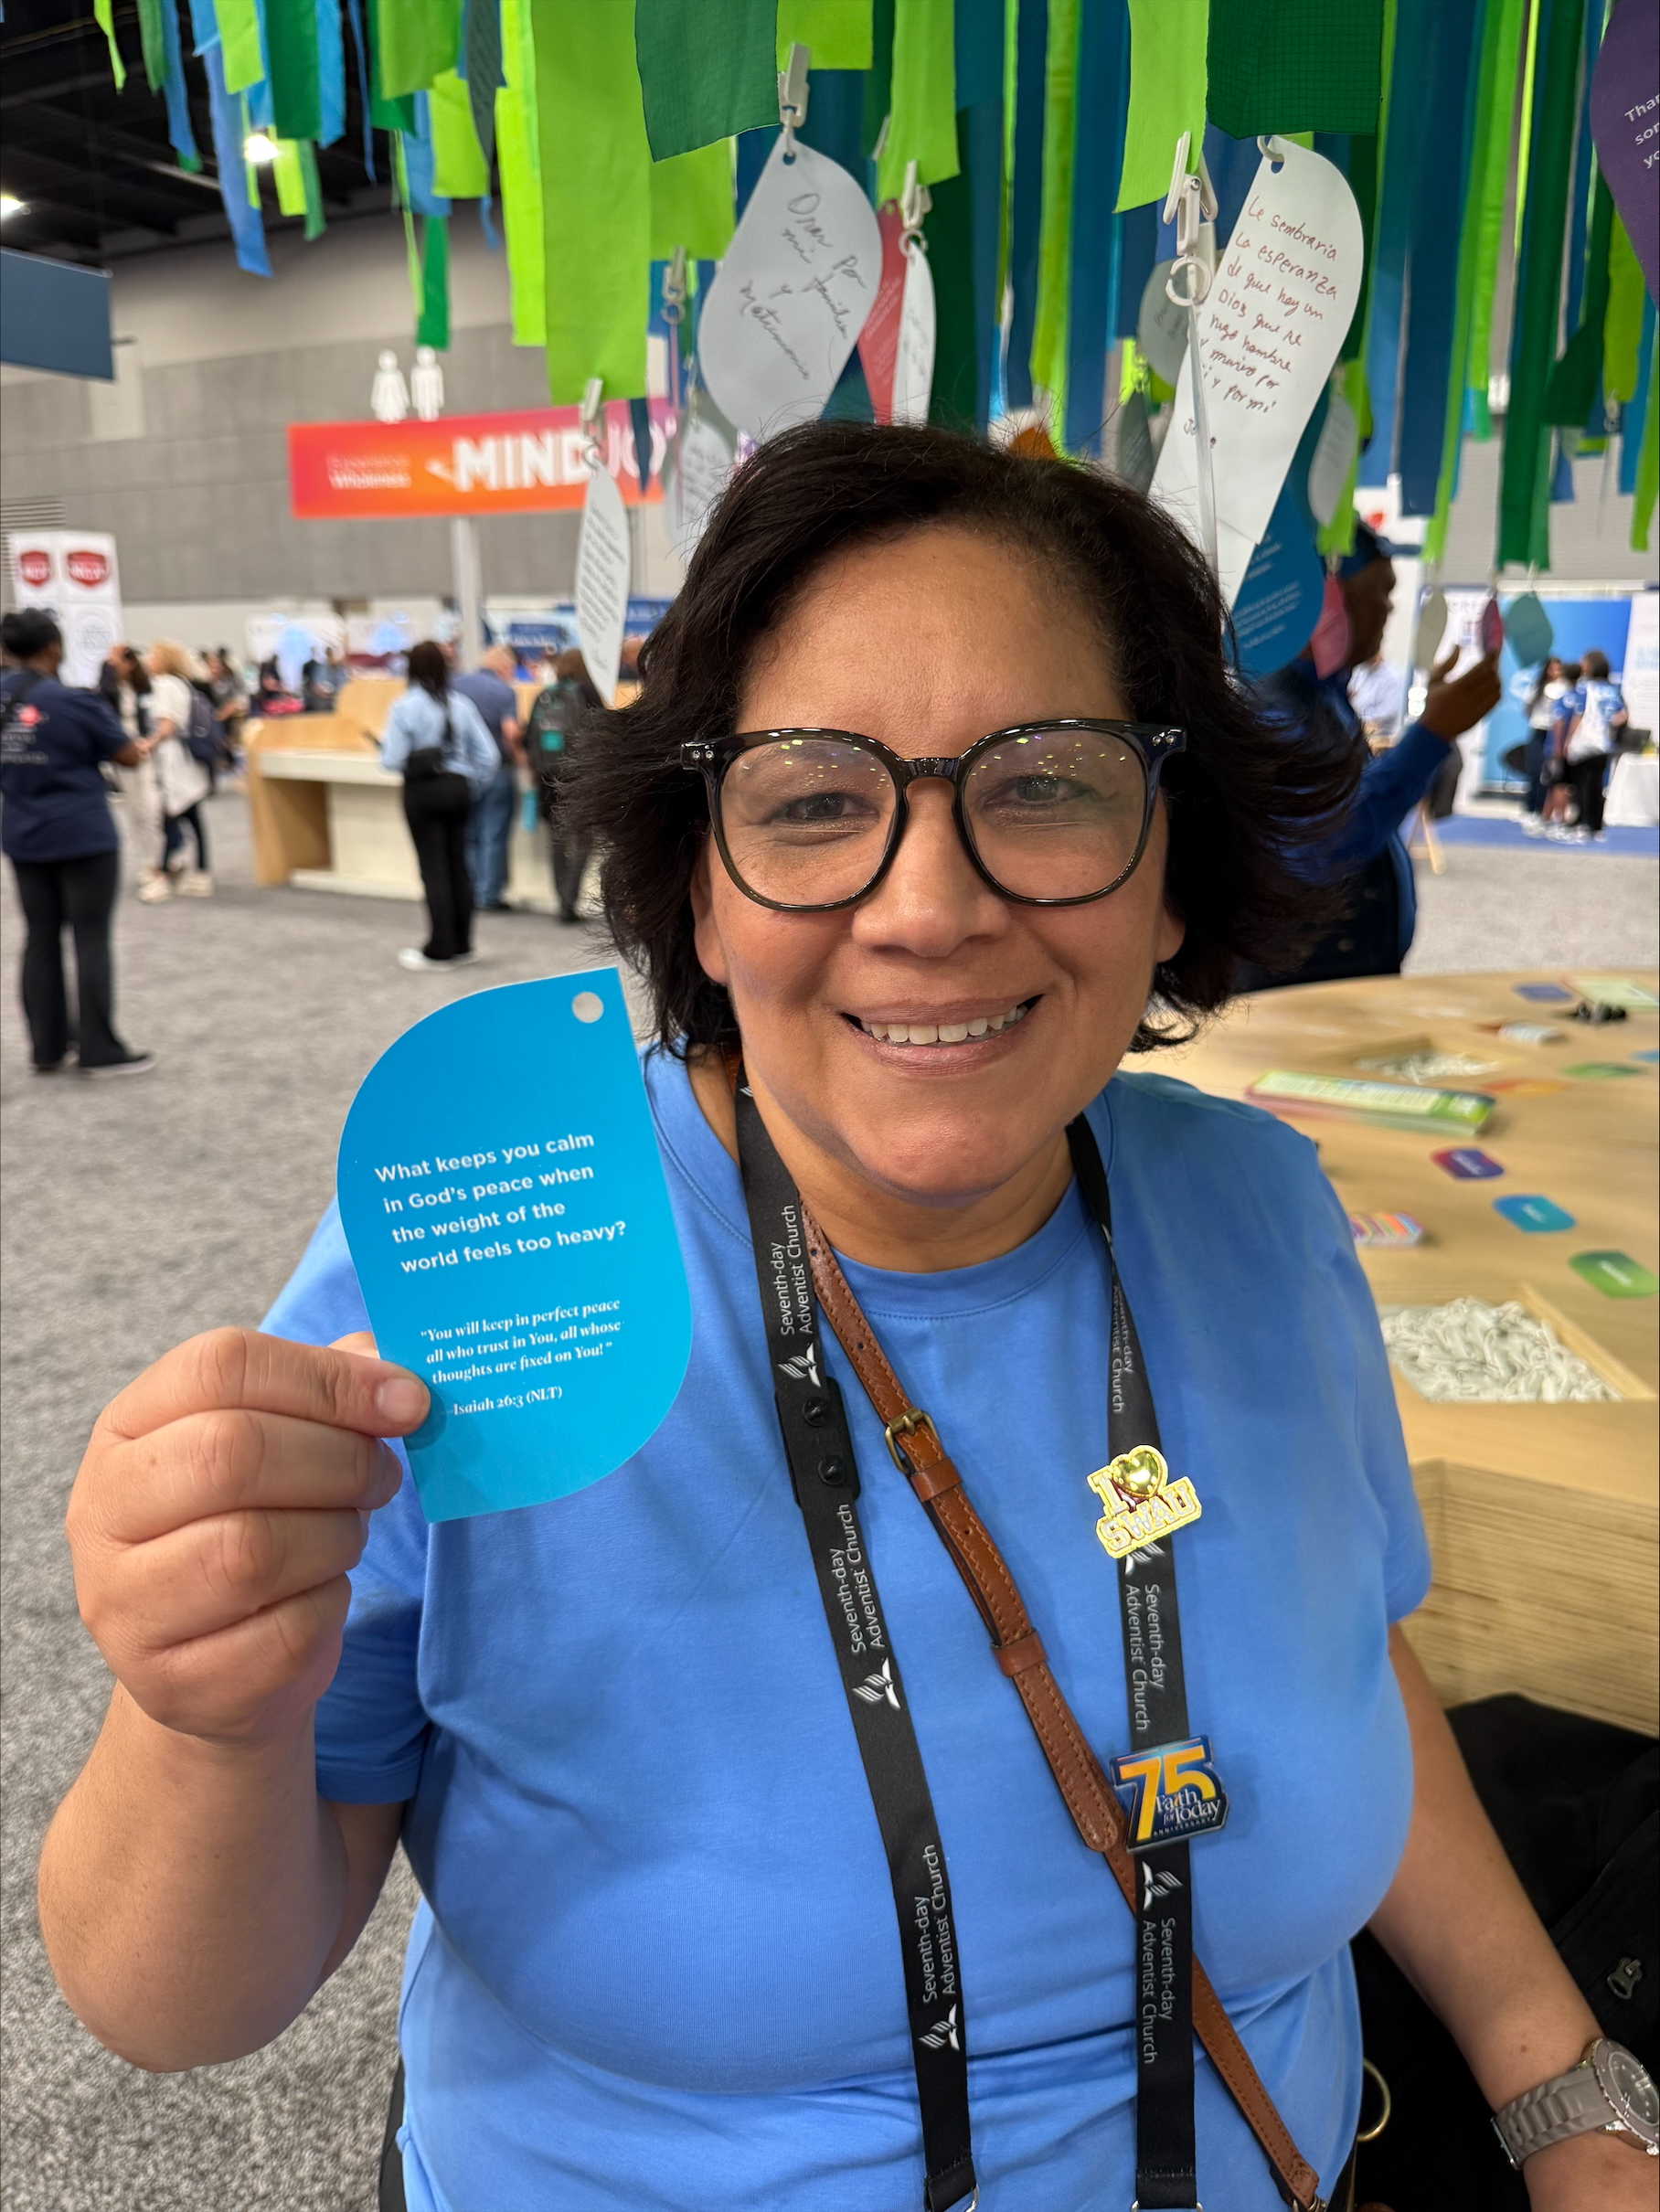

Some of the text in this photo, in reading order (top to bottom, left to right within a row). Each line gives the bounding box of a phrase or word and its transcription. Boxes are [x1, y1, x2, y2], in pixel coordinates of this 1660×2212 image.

[1248, 196, 1264, 221] Le
[1228, 256, 1242, 277] de
[1244, 273, 1270, 293] que
[1277, 287, 1300, 317] hay
[1257, 245, 1337, 301] esperanza
[1252, 314, 1281, 333] que
[375, 1133, 594, 1182] What keeps you calm
[383, 1165, 594, 1213] in God’s peace when
[392, 1201, 566, 1244] the weight of the
[401, 1220, 626, 1273] world feels too heavy?
[771, 1241, 795, 1335] Seventh-day
[782, 1204, 814, 1335] Adventist Church
[426, 1320, 622, 1364] all who trust in You, all whose
[455, 1321, 479, 1336] will
[483, 1318, 513, 1334] keep
[516, 1313, 529, 1326] in
[532, 1305, 580, 1327] perfect
[582, 1299, 621, 1318] peace
[431, 1364, 493, 1384] thoughts
[495, 1358, 516, 1372] are
[520, 1351, 552, 1371] fixed
[554, 1351, 572, 1363] on
[1112, 1358, 1126, 1413] Church
[496, 1394, 524, 1409] 26:3
[527, 1386, 563, 1405] (NLT)
[1091, 1470, 1130, 1515] I
[1100, 1480, 1198, 1552] SWAU
[829, 1547, 867, 1654] Seventh-day
[836, 1504, 885, 1648] Adventist Church
[1125, 1583, 1151, 1730] Adventist Church
[1144, 1582, 1167, 1690] Seventh-day
[1119, 1744, 1216, 1841] 75
[1156, 1788, 1198, 1813] Faith
[1163, 1798, 1220, 1825] for Today
[1153, 1817, 1211, 1837] ANNIVERSARY
[922, 1844, 956, 1994] Adventist Church
[914, 1896, 938, 2004] Seventh-day
[1158, 1917, 1176, 2021] Seventh-day
[1143, 1920, 1158, 2064] Adventist Church
